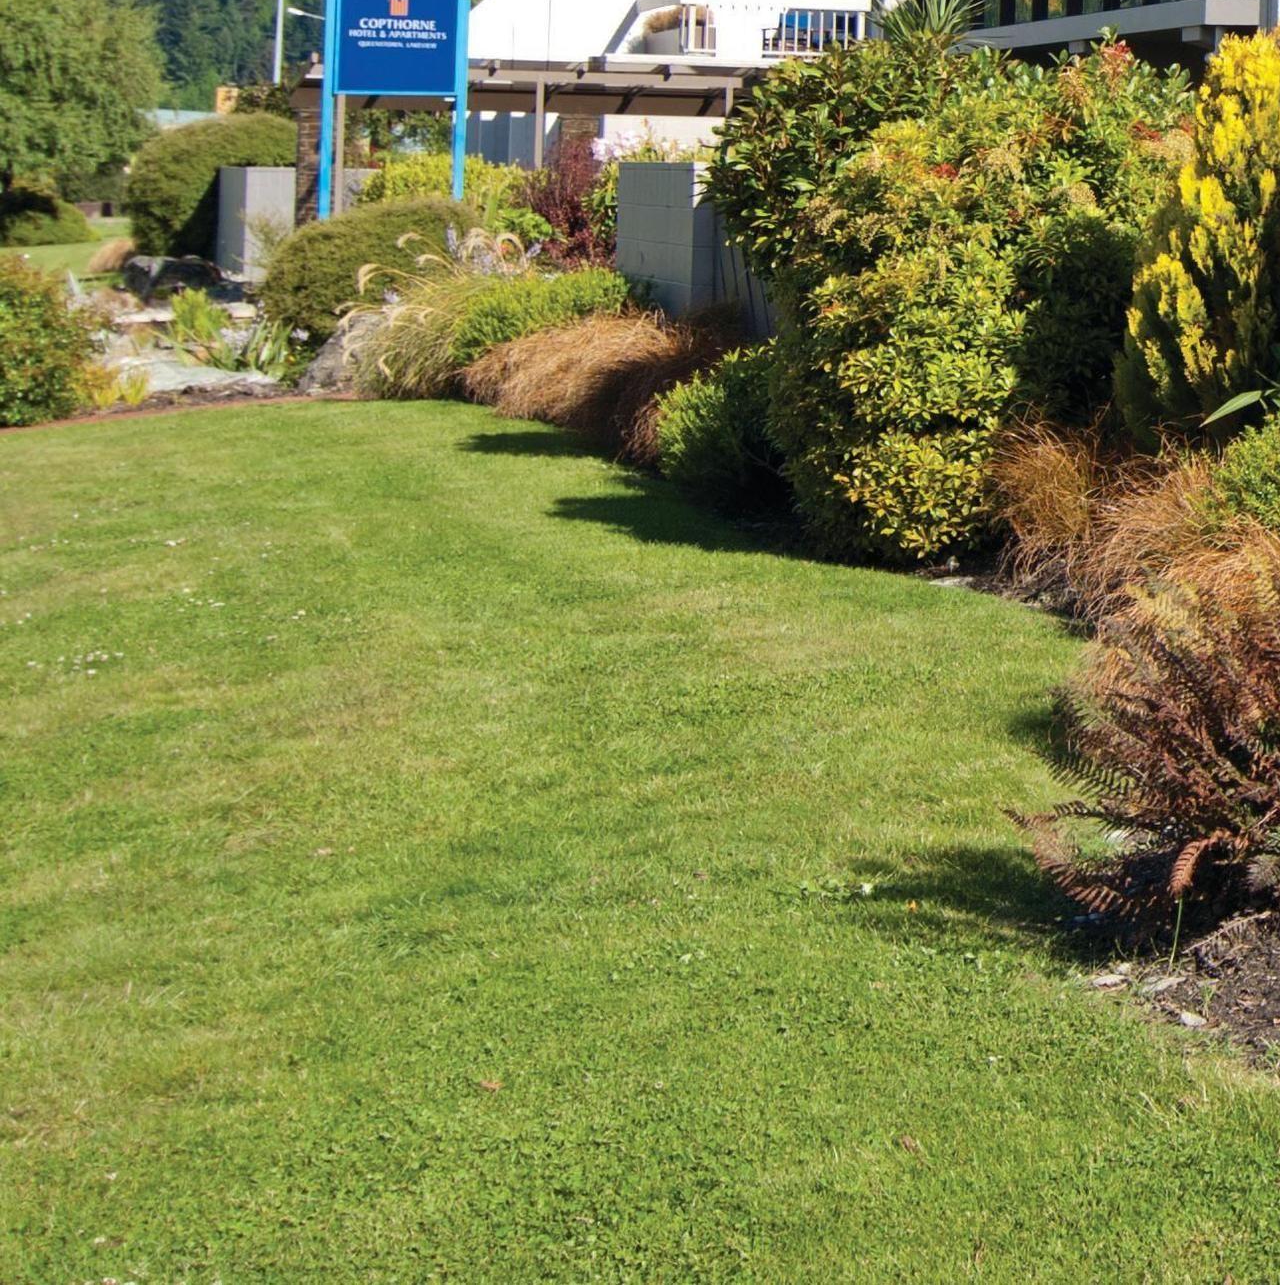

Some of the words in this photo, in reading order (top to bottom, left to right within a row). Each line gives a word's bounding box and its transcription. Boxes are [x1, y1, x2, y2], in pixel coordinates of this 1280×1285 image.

[359, 18, 437, 31] COPTHORNE
[349, 29, 377, 38] HOTEL
[379, 30, 387, 38] &
[388, 30, 447, 40] APARTMENTS
